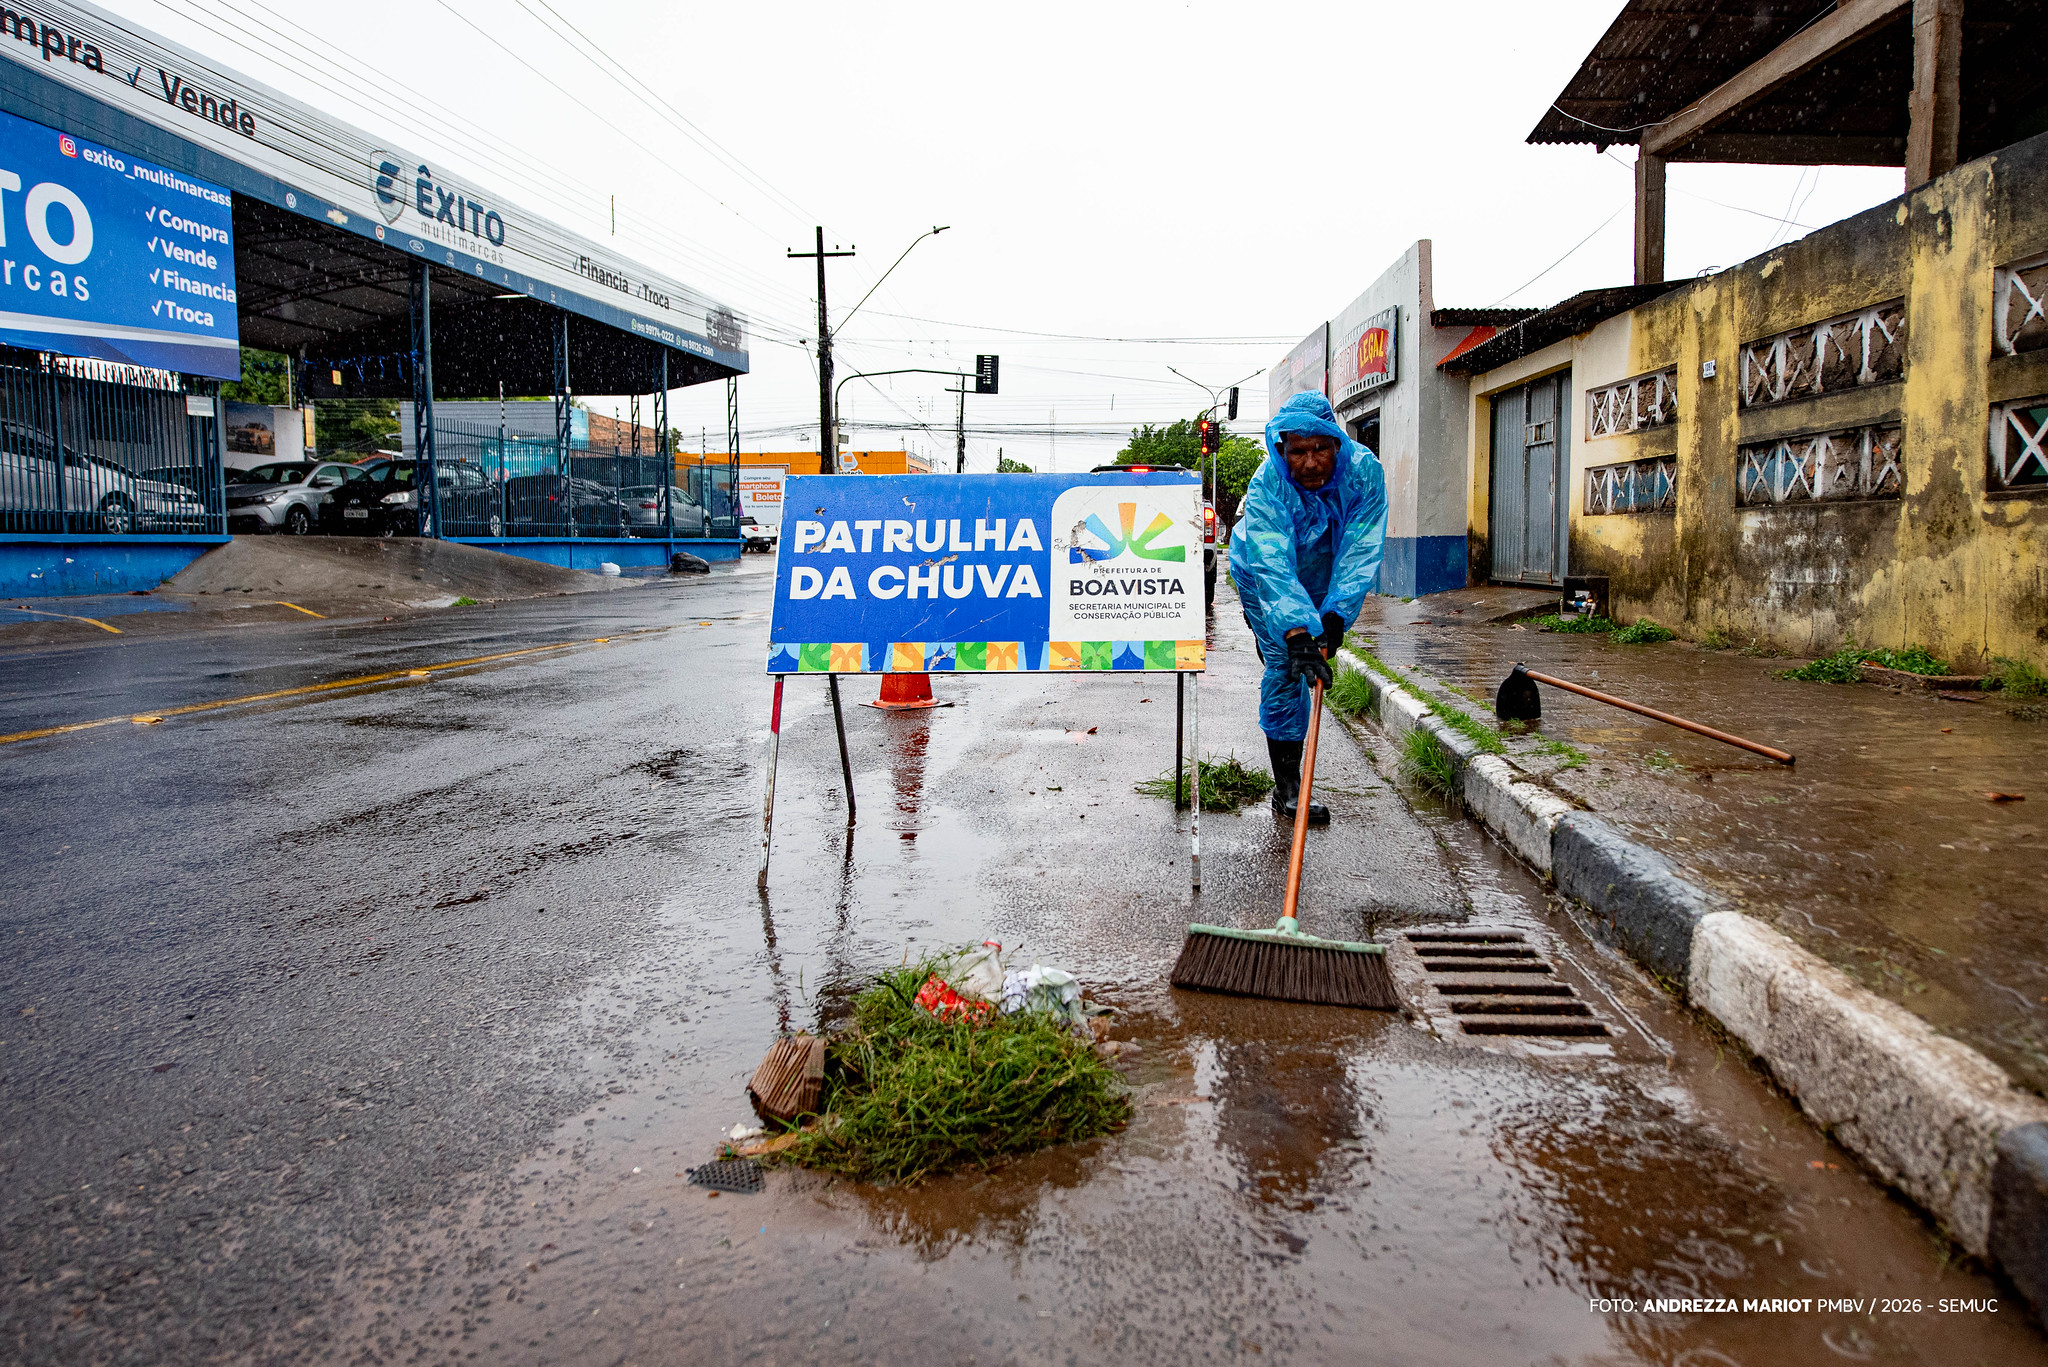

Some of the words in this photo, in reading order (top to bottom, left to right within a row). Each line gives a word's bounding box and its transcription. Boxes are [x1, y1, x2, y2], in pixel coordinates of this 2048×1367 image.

[158, 68, 256, 136] Vende
[83, 148, 232, 207] exito_multimarcass
[417, 164, 505, 247] ÊXITO
[158, 208, 229, 245] Compra
[420, 220, 504, 264] multimarcas
[160, 238, 218, 270] Vende
[4, 258, 90, 302] rcas
[163, 269, 238, 304] Financia
[580, 255, 629, 294] Financia
[643, 283, 670, 310] Troca
[164, 300, 214, 327] Troca
[1359, 330, 1384, 369] LEGAL
[739, 482, 777, 491] martphone
[793, 518, 1044, 554] PATRULHA
[789, 566, 857, 600] DA
[868, 564, 1043, 600] CHUVA
[1069, 603, 1121, 611] SECRETARIA
[1123, 602, 1173, 610] MUNICIPAL
[1174, 602, 1186, 610] DE
[1073, 610, 1142, 621] CONSERVAÇÃO
[1143, 610, 1182, 619] PÚBLICA
